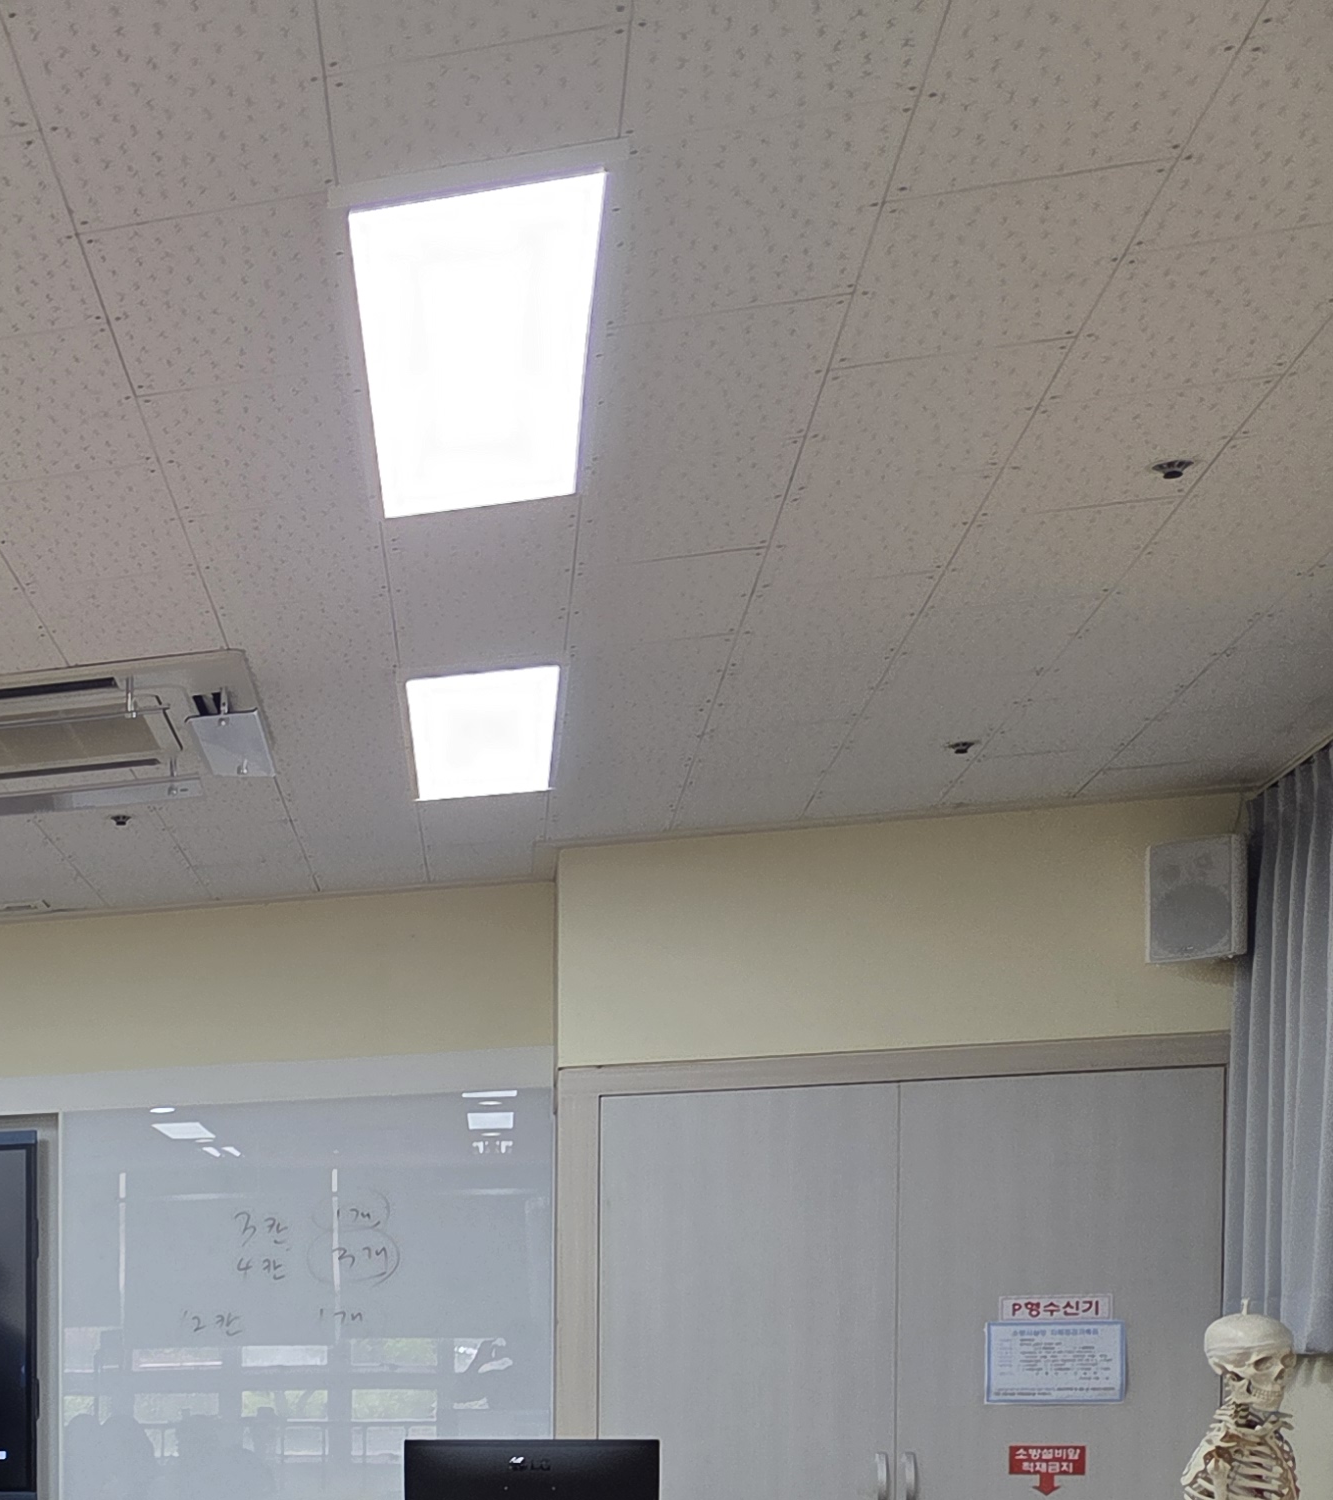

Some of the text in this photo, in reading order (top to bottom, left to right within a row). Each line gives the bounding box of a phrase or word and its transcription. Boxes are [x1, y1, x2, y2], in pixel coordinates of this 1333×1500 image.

[1011, 1300, 1100, 1318] P형수신기
[1014, 1447, 1081, 1460] 소방설비앞
[531, 1458, 551, 1471] LG
[1021, 1461, 1074, 1473] 적재금지
